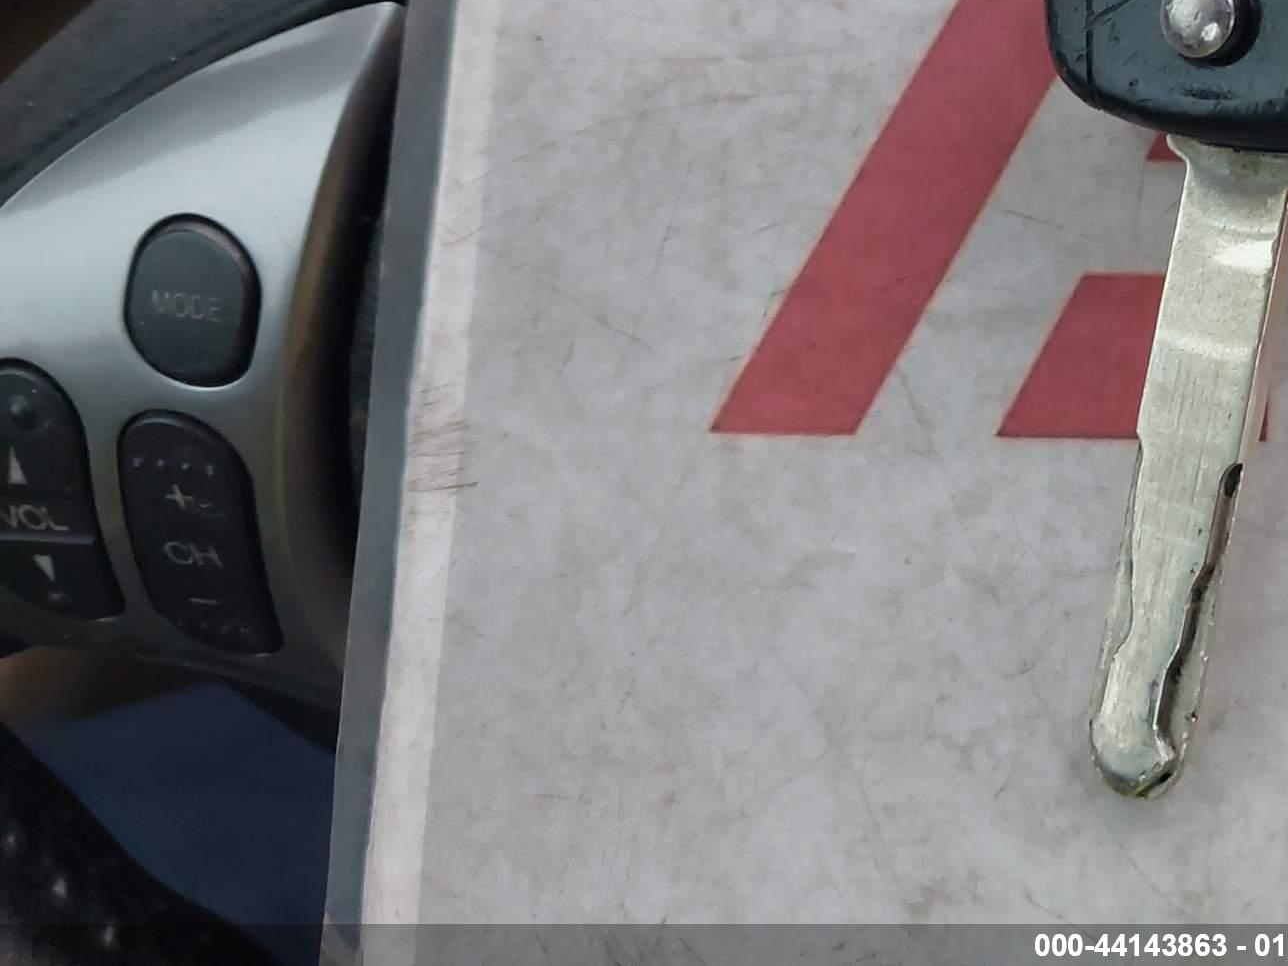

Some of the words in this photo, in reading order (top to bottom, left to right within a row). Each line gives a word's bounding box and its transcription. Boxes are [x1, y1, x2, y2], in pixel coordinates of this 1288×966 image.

[151, 289, 221, 323] MODE
[0, 503, 70, 532] VOL
[163, 541, 223, 568] CH
